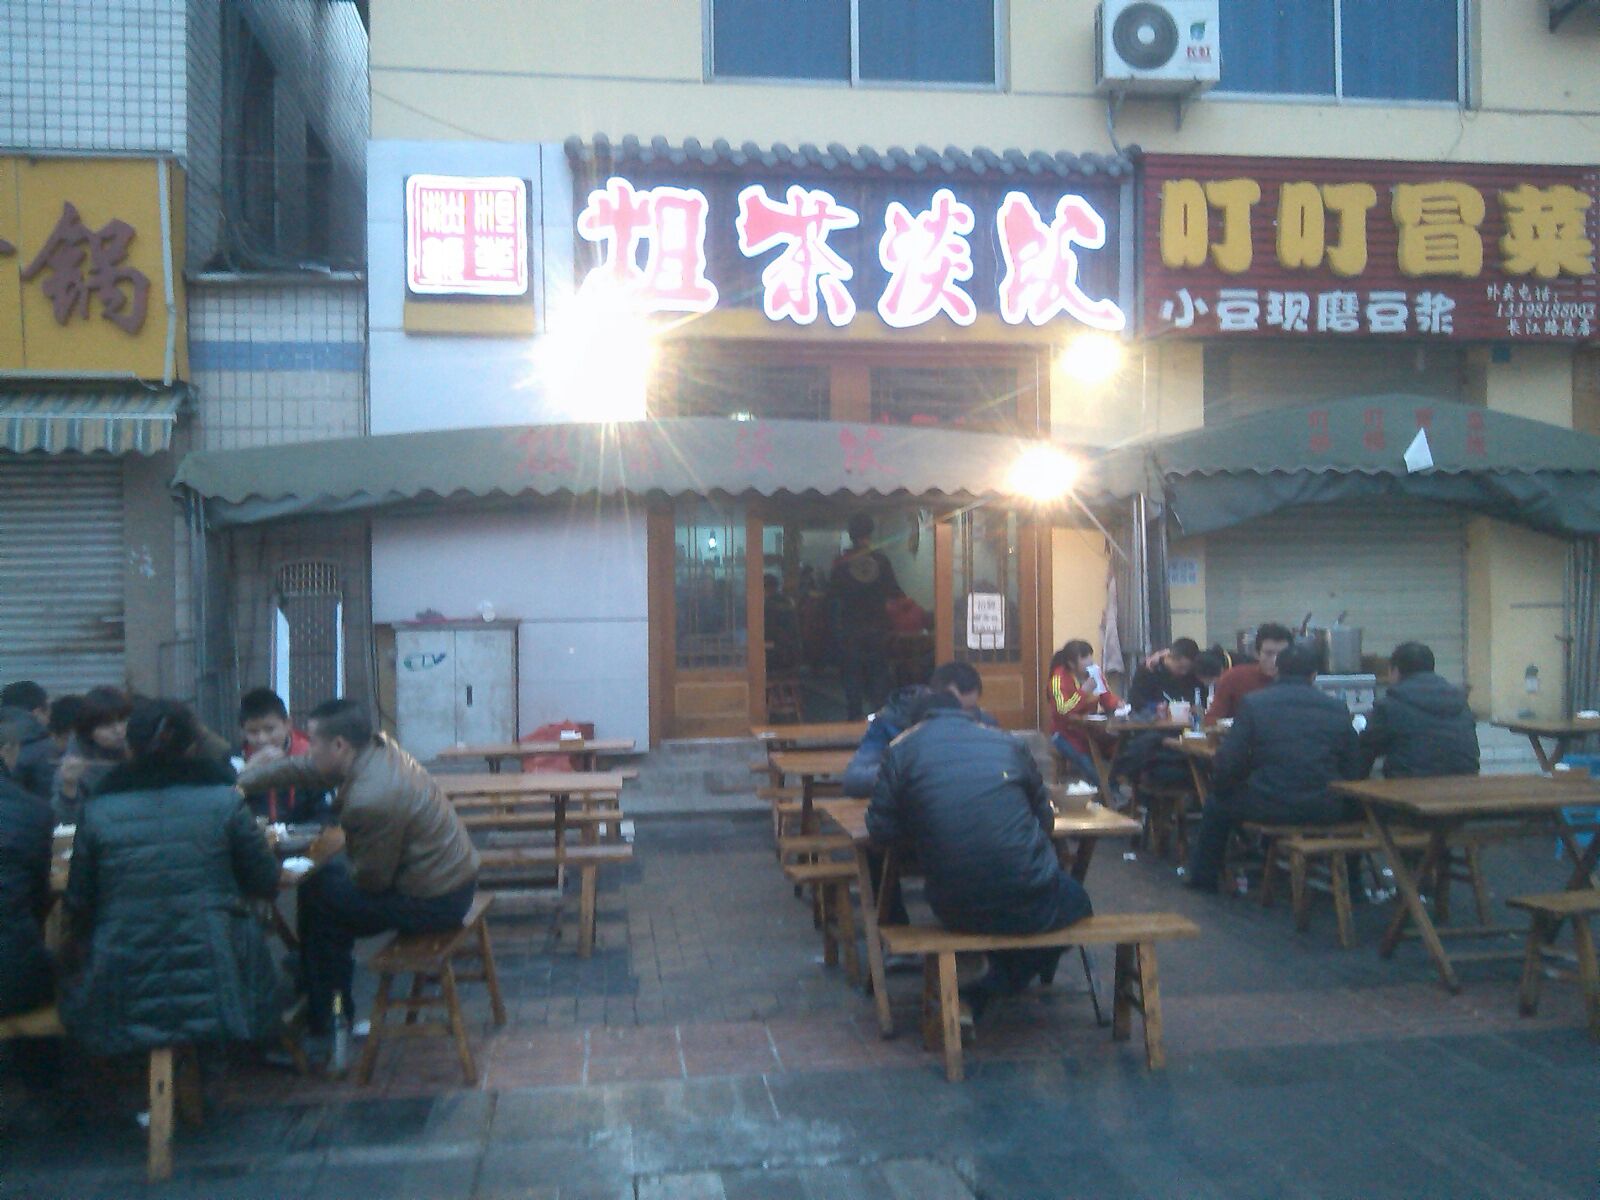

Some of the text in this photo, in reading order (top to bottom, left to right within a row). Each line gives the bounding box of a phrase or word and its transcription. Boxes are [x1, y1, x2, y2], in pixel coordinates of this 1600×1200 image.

[0, 201, 150, 335] 锅
[1160, 177, 1594, 278] 叮叮冒菜
[1160, 288, 1456, 334] 小豆现磨豆浆
